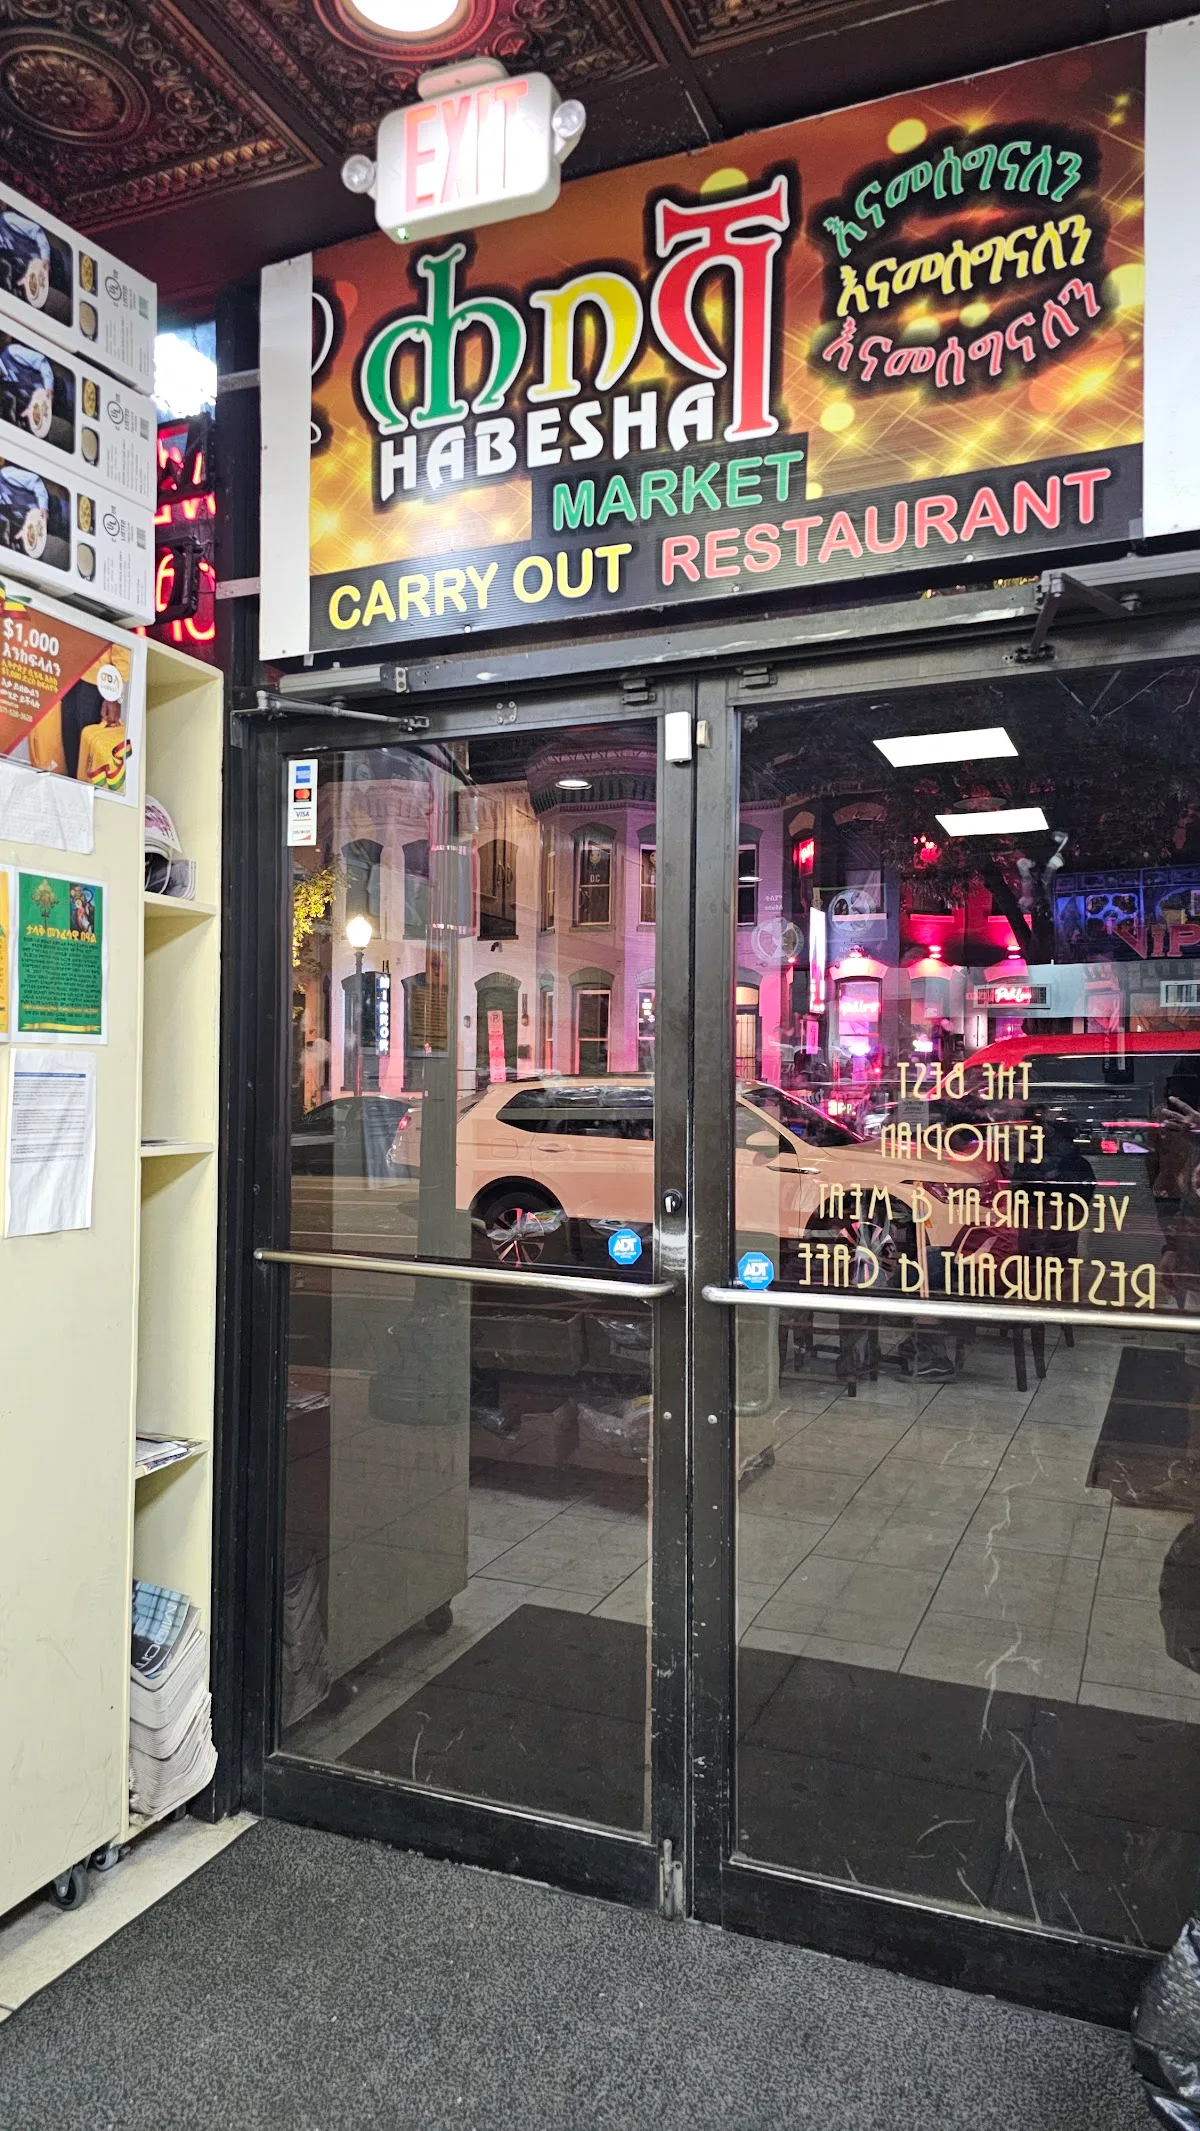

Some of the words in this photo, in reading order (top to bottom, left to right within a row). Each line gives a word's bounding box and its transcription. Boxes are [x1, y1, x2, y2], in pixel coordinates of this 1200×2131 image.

[404, 80, 528, 212] EXIT
[380, 382, 715, 501] HABESHA
[553, 451, 803, 531] MARKET
[661, 468, 1111, 586] RESTAURANT
[329, 561, 499, 630] CARRY
[512, 543, 632, 603] OUT
[379, 976, 389, 1052] MIRROR
[613, 1238, 636, 1252] ADT
[743, 1262, 768, 1276] ADT
